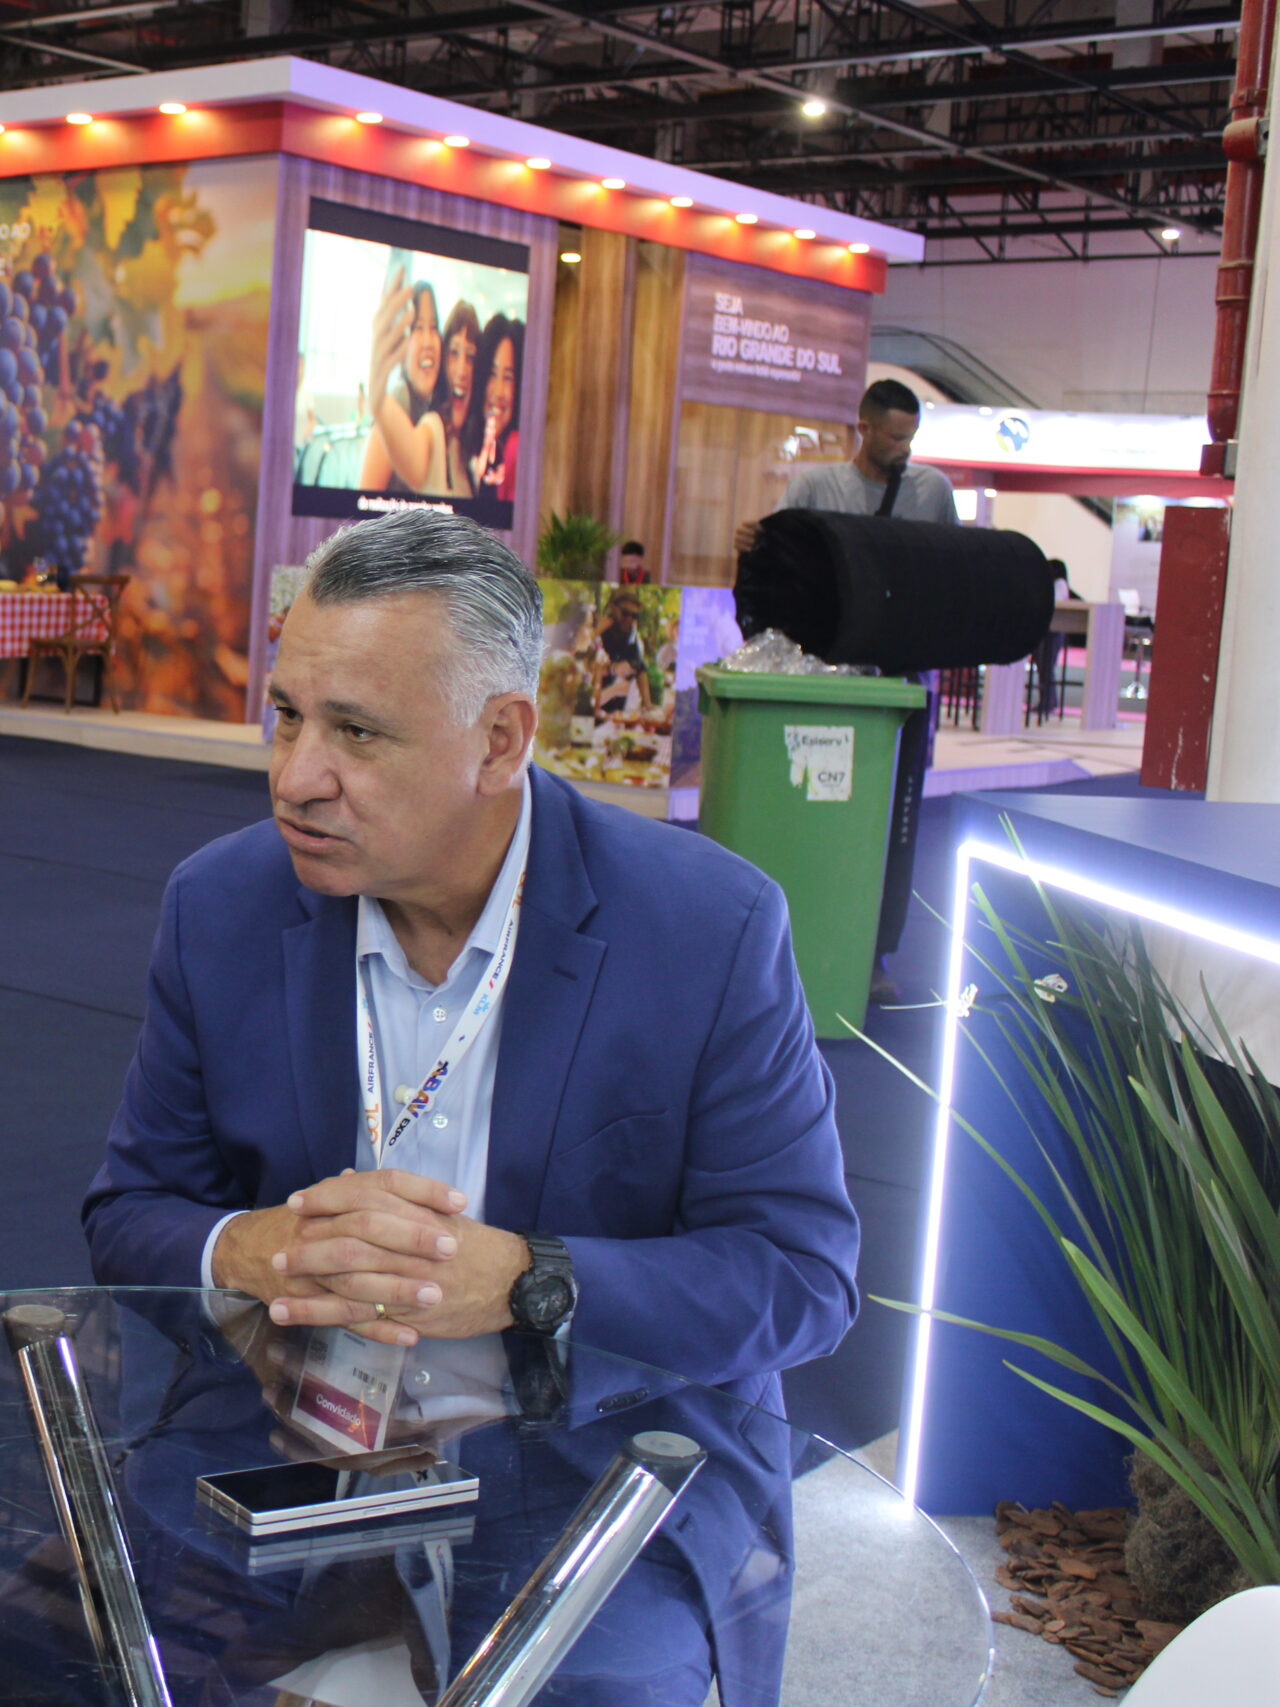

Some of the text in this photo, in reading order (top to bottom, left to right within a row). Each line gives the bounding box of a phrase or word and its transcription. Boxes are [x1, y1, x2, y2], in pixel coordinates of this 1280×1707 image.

[715, 292, 744, 315] SEJA
[713, 313, 790, 344] BEM-VINDO AO
[712, 334, 738, 358] RIO
[740, 338, 795, 367] GRANDE
[796, 347, 816, 371] DO
[816, 351, 843, 376] SUL
[818, 771, 845, 784] CN7
[493, 919, 514, 979] AIRFRANCE
[367, 1031, 377, 1094] AIRFRANCE
[408, 1060, 448, 1118] ABAV
[365, 1104, 379, 1144] GOL
[389, 1117, 410, 1146] EXPO
[316, 1393, 361, 1426] Convidado
